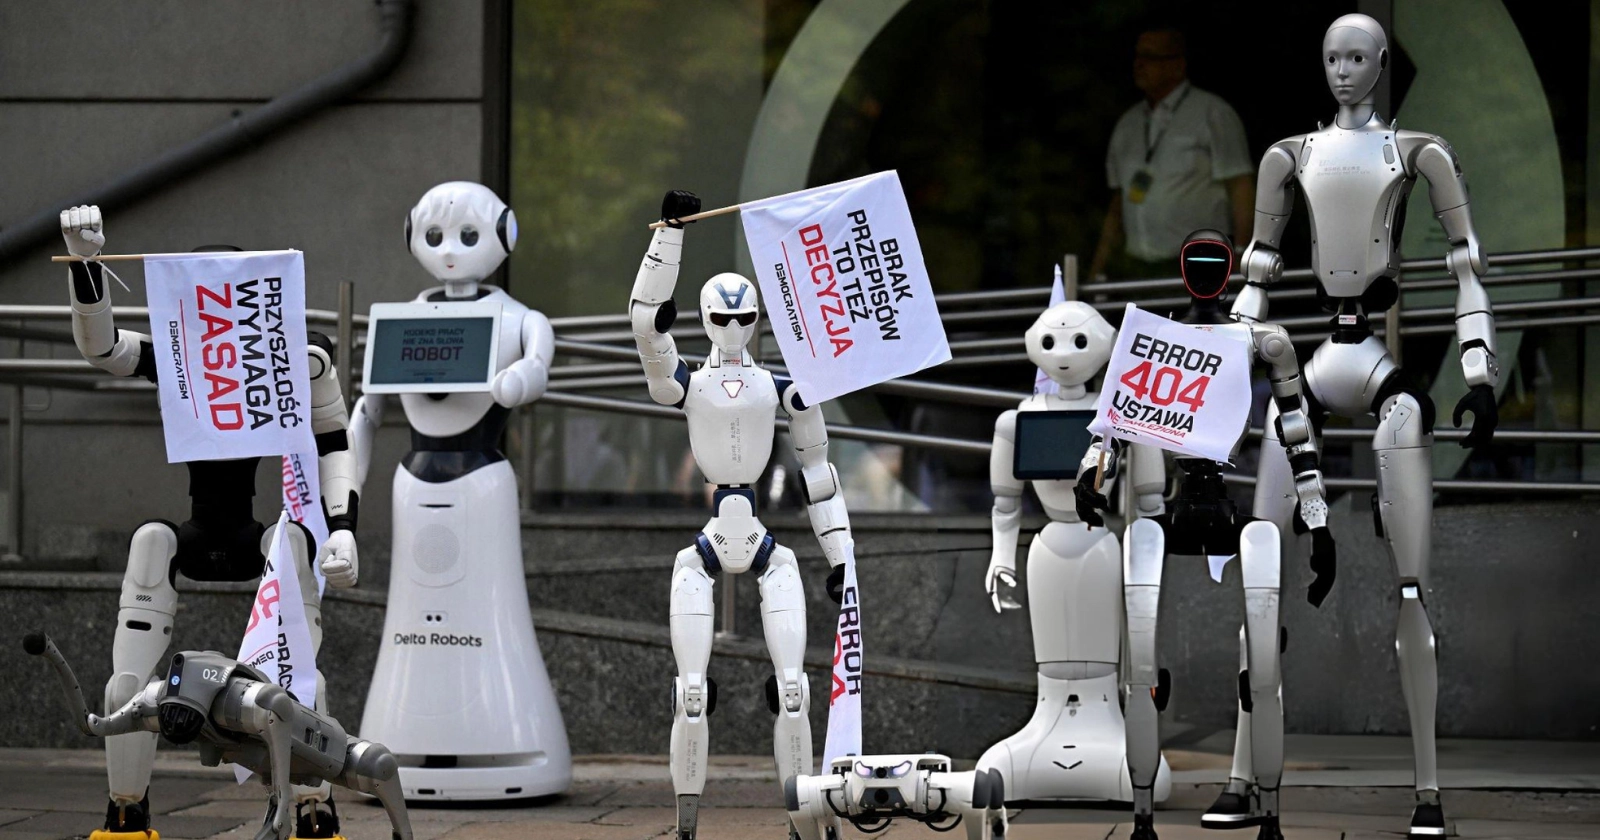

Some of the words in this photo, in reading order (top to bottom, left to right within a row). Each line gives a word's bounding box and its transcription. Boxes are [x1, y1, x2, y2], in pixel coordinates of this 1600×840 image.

[833, 241, 856, 275] TO
[847, 209, 901, 341] PRZEPISÓW
[880, 238, 913, 304] BRAK
[774, 263, 804, 342] DEMOCRATISM
[798, 223, 854, 358] DECYZJA
[843, 277, 873, 324] TEŻ
[168, 320, 189, 400] DEMOCRATISM
[195, 283, 245, 431] ZASAD
[235, 279, 274, 431] WYMAGA
[264, 277, 303, 429] PRZYSZŁOŚĆ
[401, 346, 464, 361] ROBOT
[438, 328, 465, 336] PRACY
[1130, 333, 1222, 376] ERROR
[1112, 390, 1194, 433] USTAWA
[1120, 361, 1210, 413] 404
[394, 633, 426, 646] Delta
[430, 633, 483, 648] Robots
